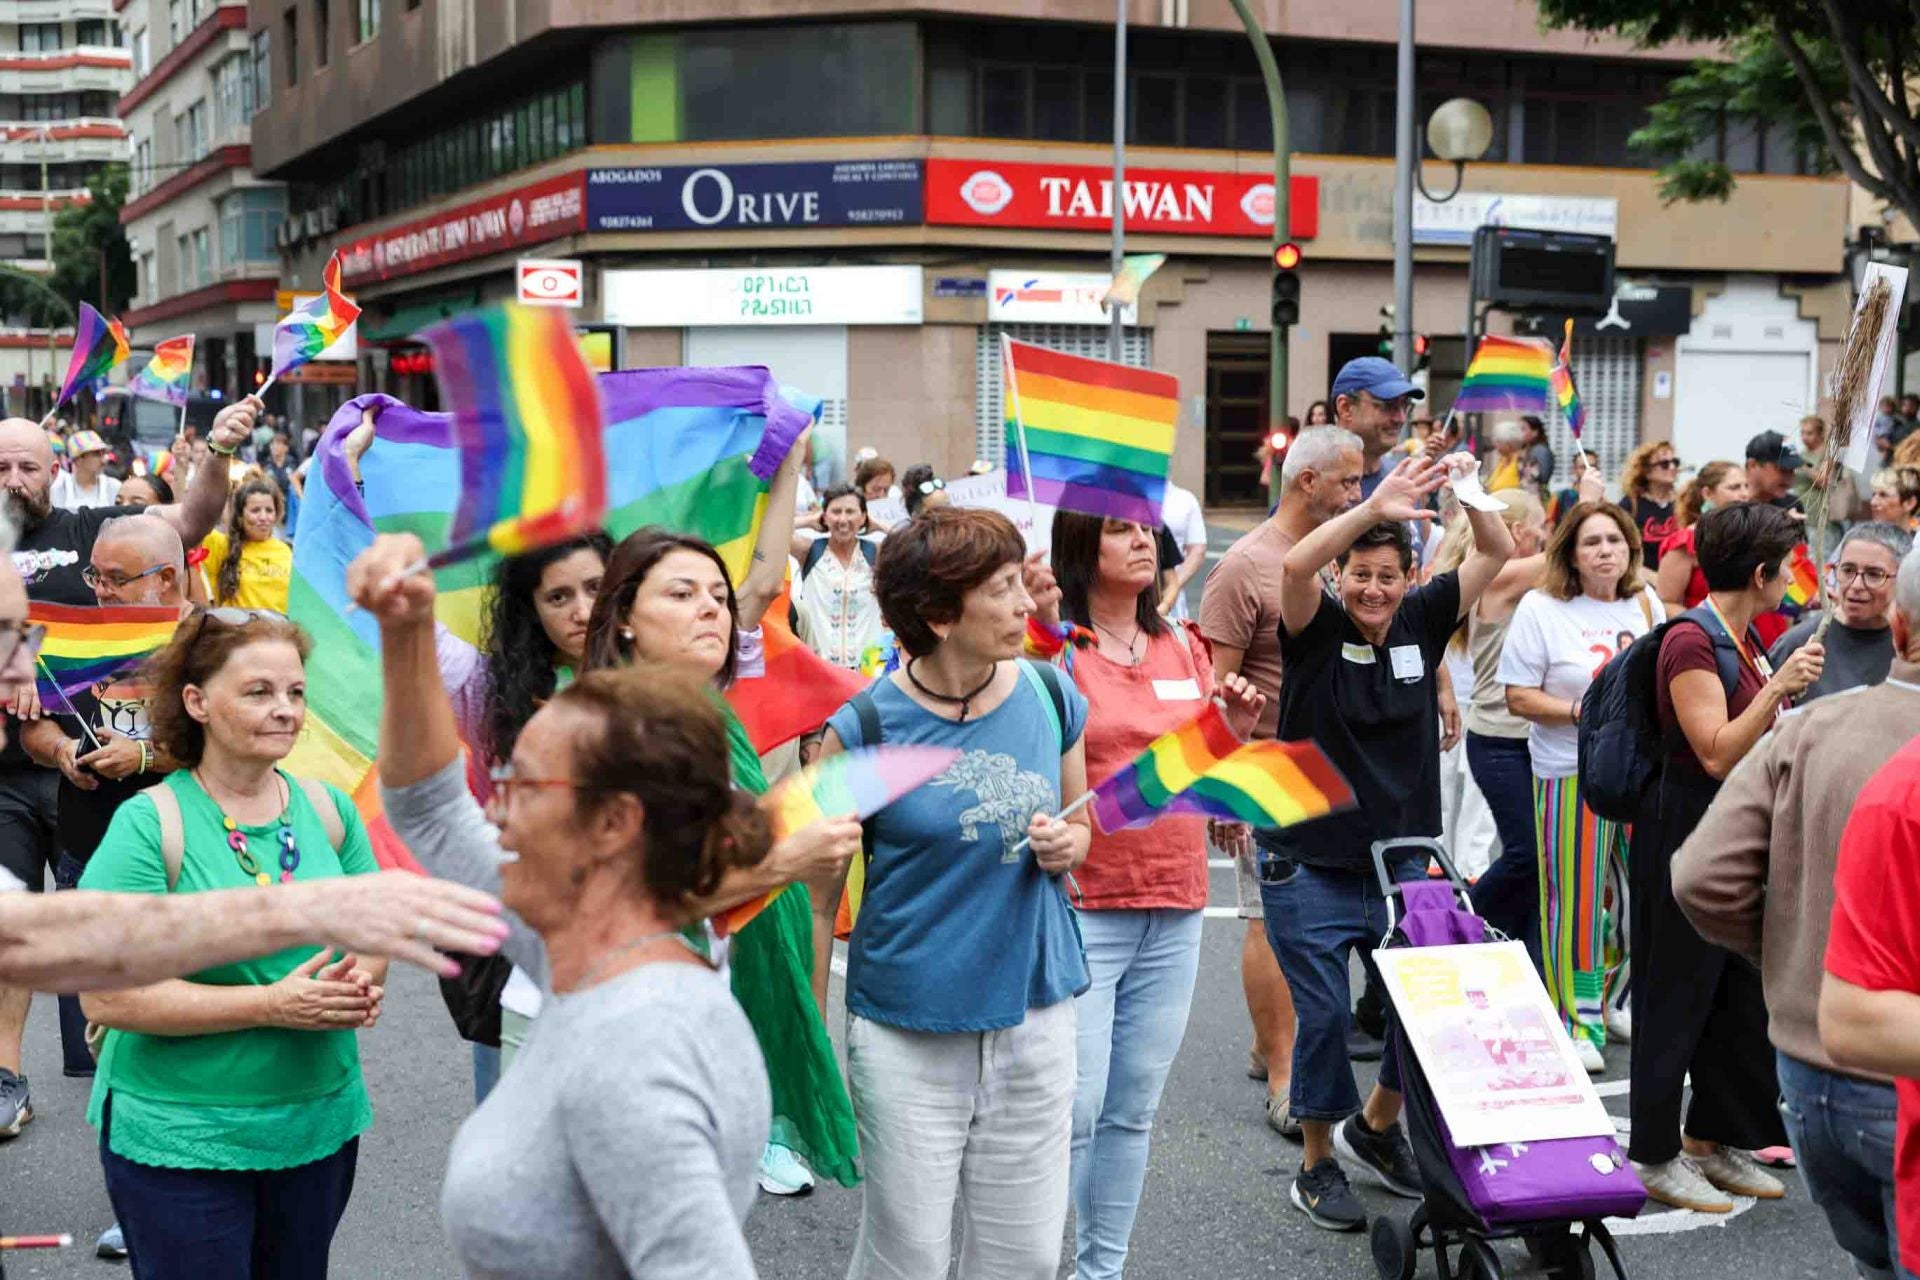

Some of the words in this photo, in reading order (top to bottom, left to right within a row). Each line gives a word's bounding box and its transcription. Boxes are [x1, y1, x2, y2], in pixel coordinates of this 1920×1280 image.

[589, 169, 662, 183] ABOGADOS
[681, 168, 820, 224] ORIVE
[1040, 177, 1214, 223] TAIWAN
